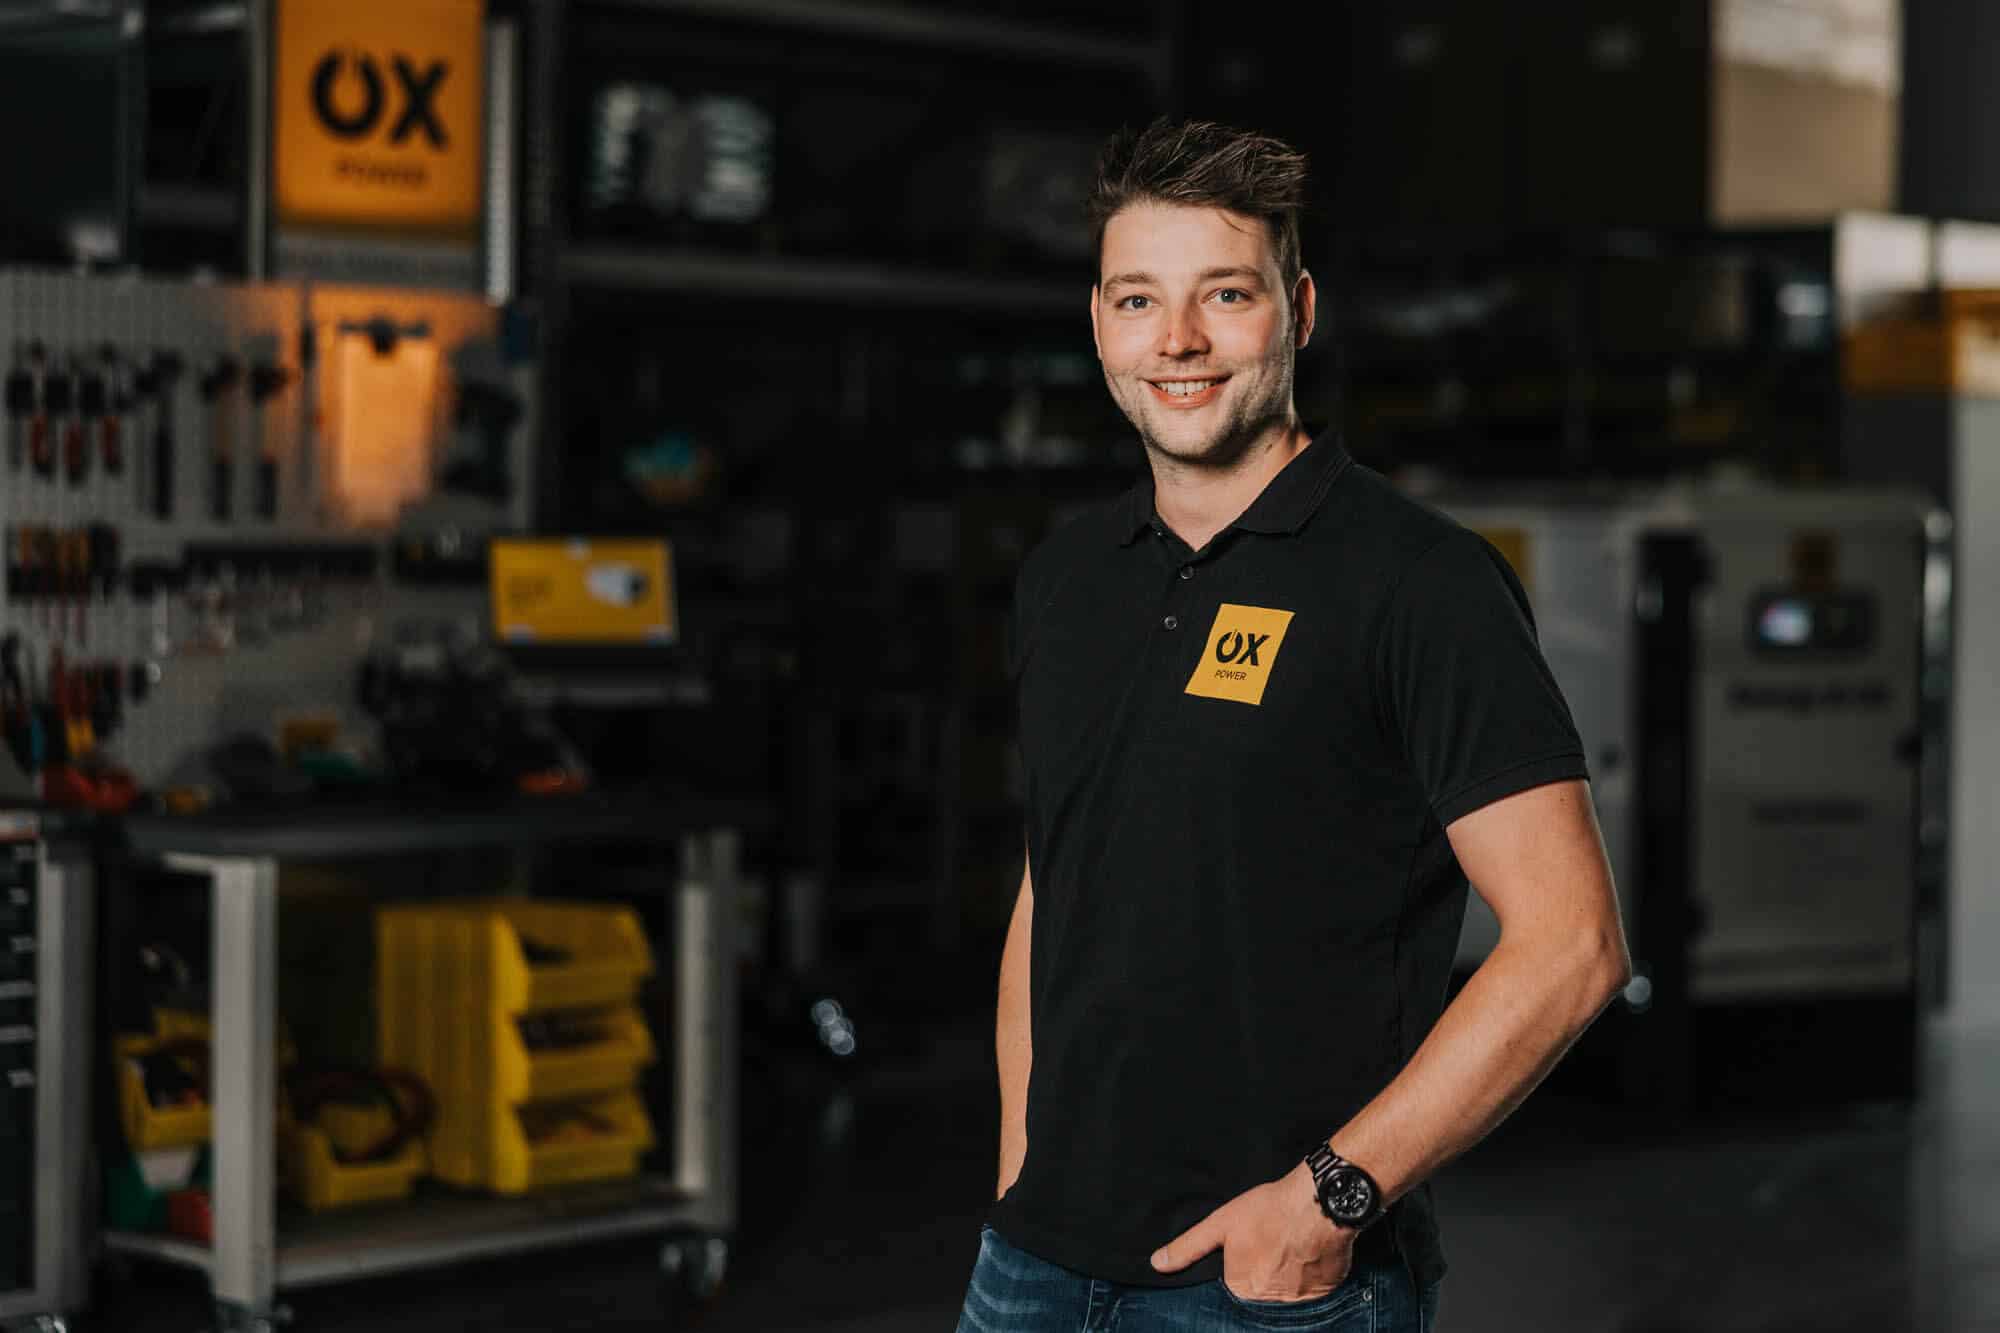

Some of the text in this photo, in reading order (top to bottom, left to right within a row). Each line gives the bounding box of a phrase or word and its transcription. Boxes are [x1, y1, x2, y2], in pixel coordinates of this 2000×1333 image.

[311, 48, 450, 150] OX
[1215, 629, 1270, 666] OX
[1214, 669, 1248, 681] POWER
